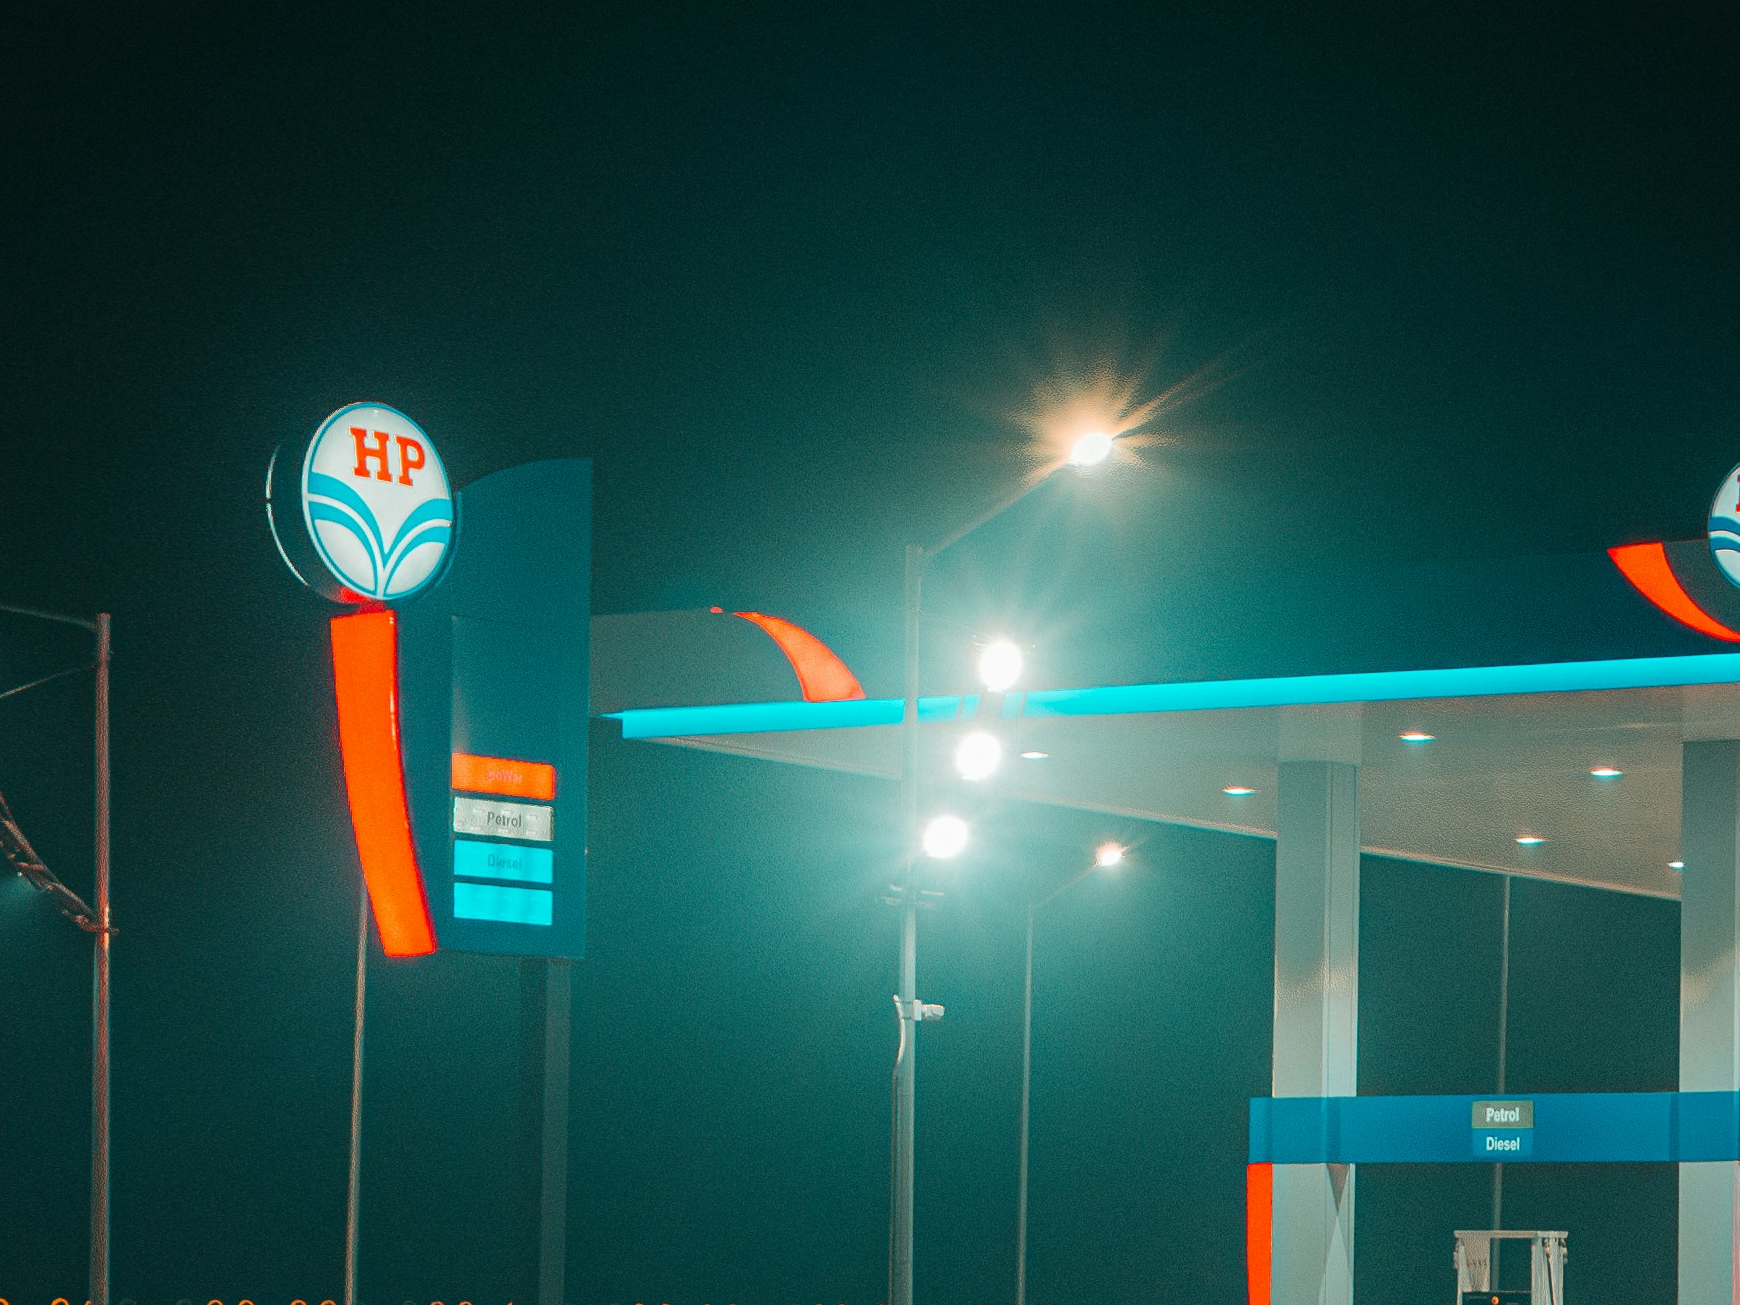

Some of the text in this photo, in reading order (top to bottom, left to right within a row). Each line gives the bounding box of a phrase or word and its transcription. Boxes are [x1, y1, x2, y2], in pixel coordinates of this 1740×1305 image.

[349, 426, 425, 487] HP
[487, 811, 523, 828] Petrol
[487, 854, 523, 870] Diesel
[1485, 1106, 1520, 1122] Petrol
[1485, 1136, 1521, 1151] Diesel
